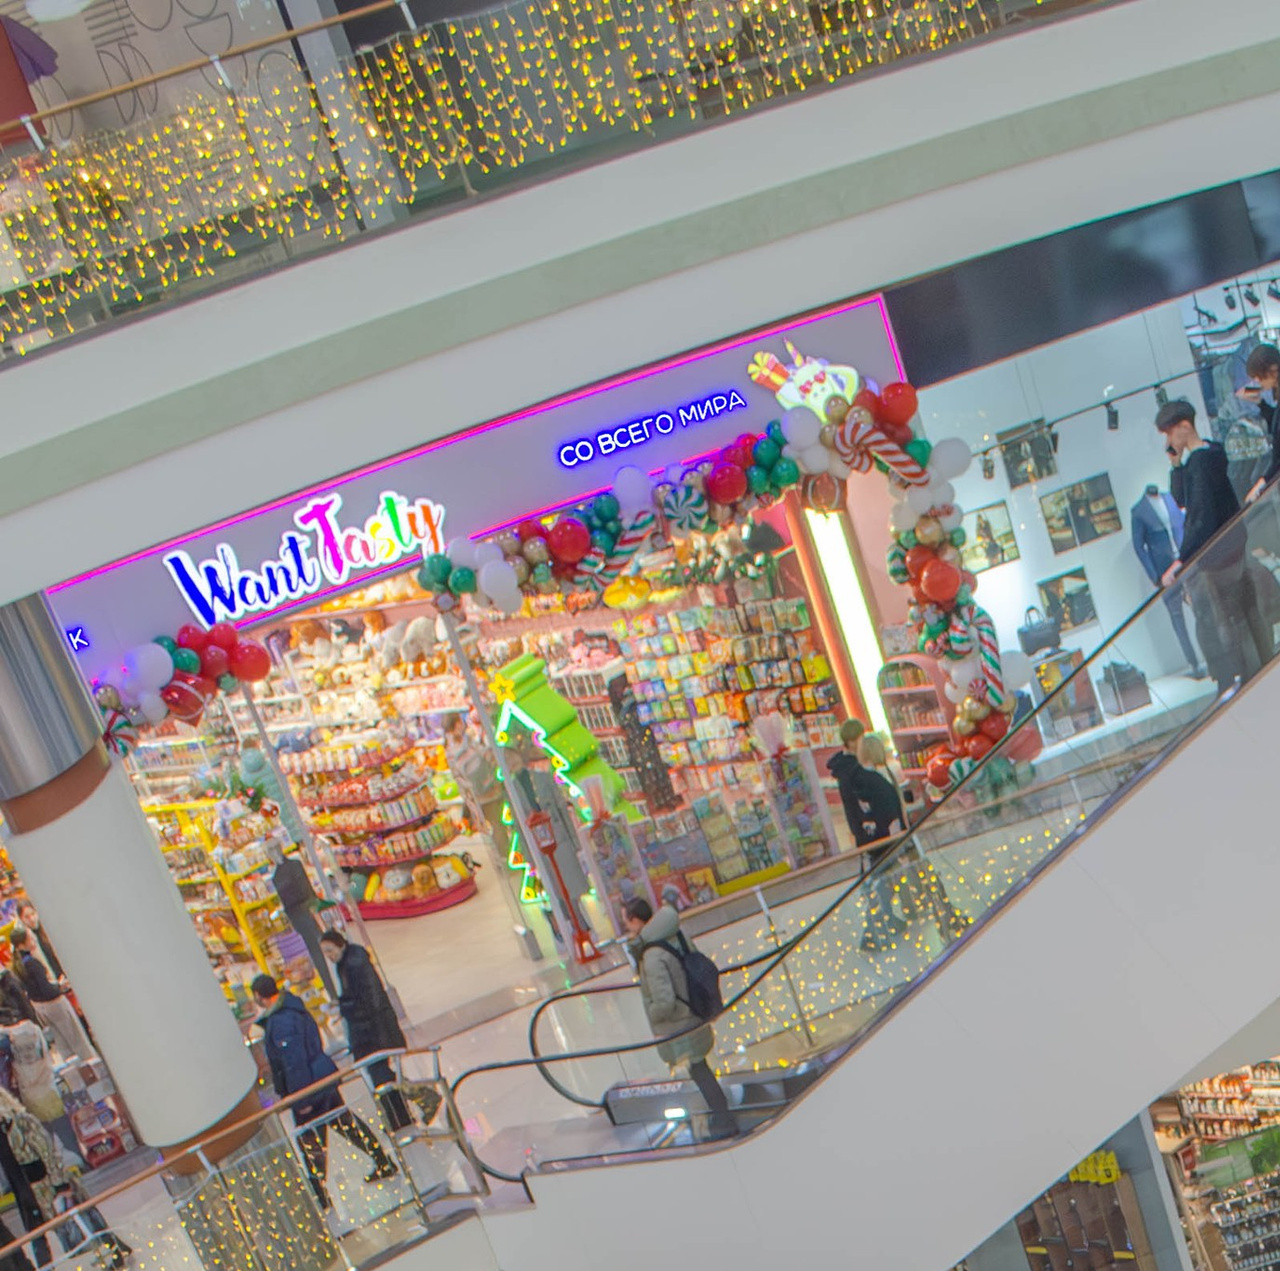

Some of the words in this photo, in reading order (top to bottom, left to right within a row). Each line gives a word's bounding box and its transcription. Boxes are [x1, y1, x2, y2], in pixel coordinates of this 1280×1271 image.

[559, 441, 594, 467] СО
[597, 413, 674, 455] ВСЕГО
[678, 390, 746, 427] МИРА
[165, 532, 321, 629] Want
[295, 491, 445, 581] Tasty
